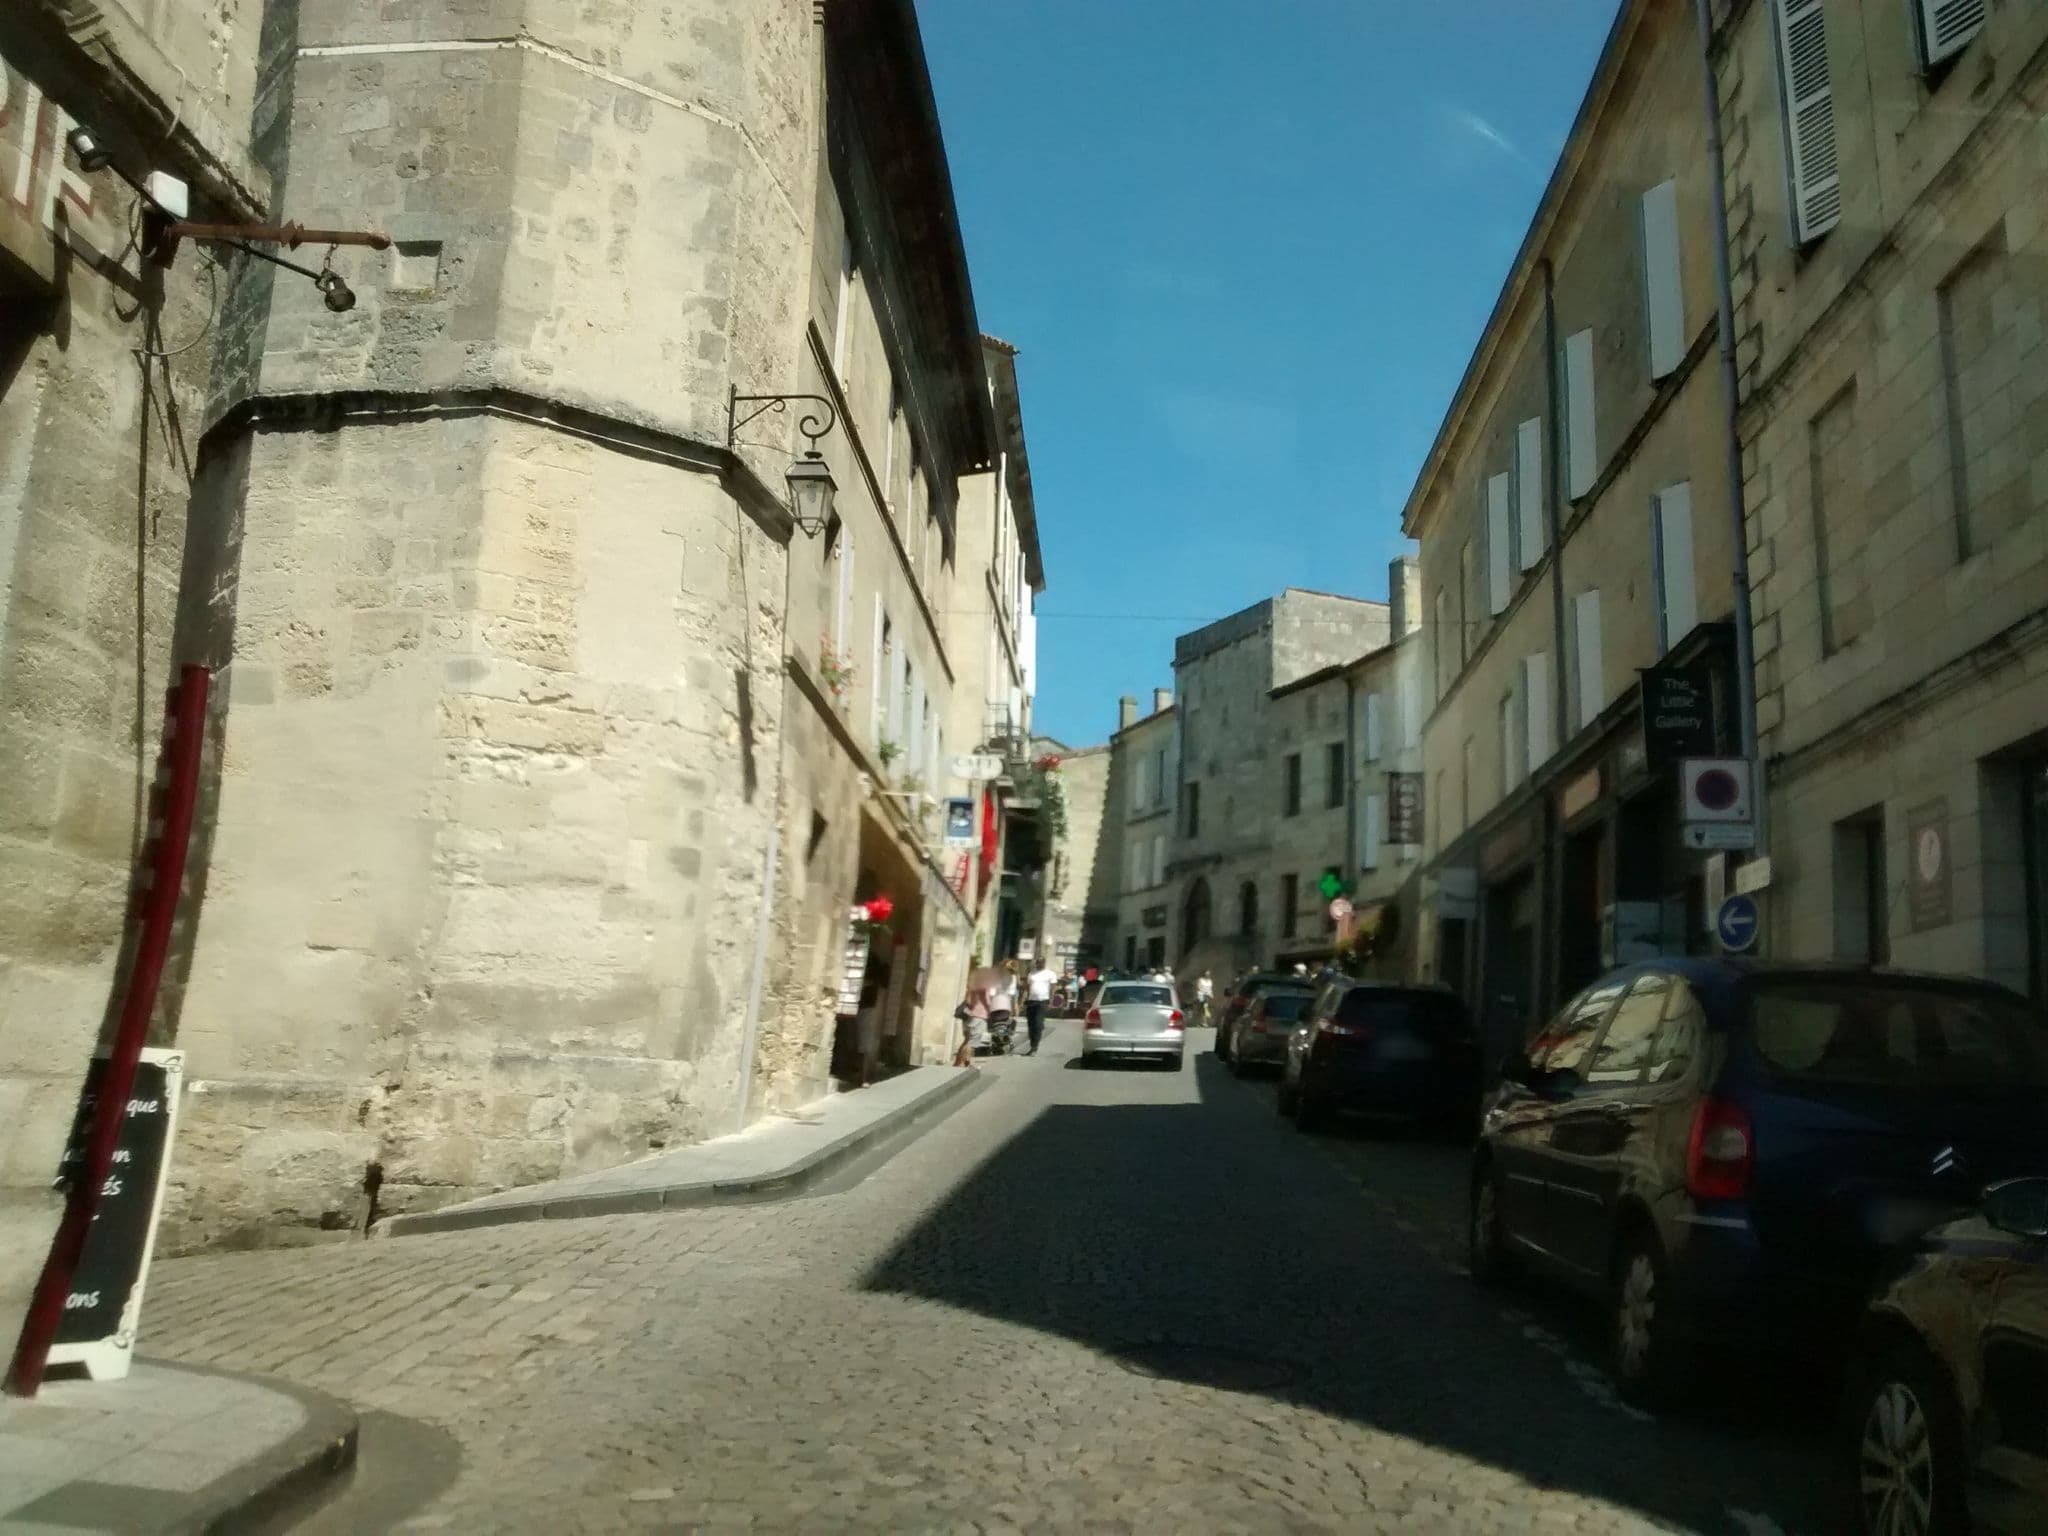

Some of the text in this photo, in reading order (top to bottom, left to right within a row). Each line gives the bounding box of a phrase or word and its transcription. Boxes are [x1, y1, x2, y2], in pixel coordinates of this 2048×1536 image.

[1663, 677, 1690, 689] The
[1661, 695, 1695, 708] Little
[1655, 715, 1703, 730] Gallery
[125, 1098, 159, 1118] que
[64, 1290, 101, 1310] ons
